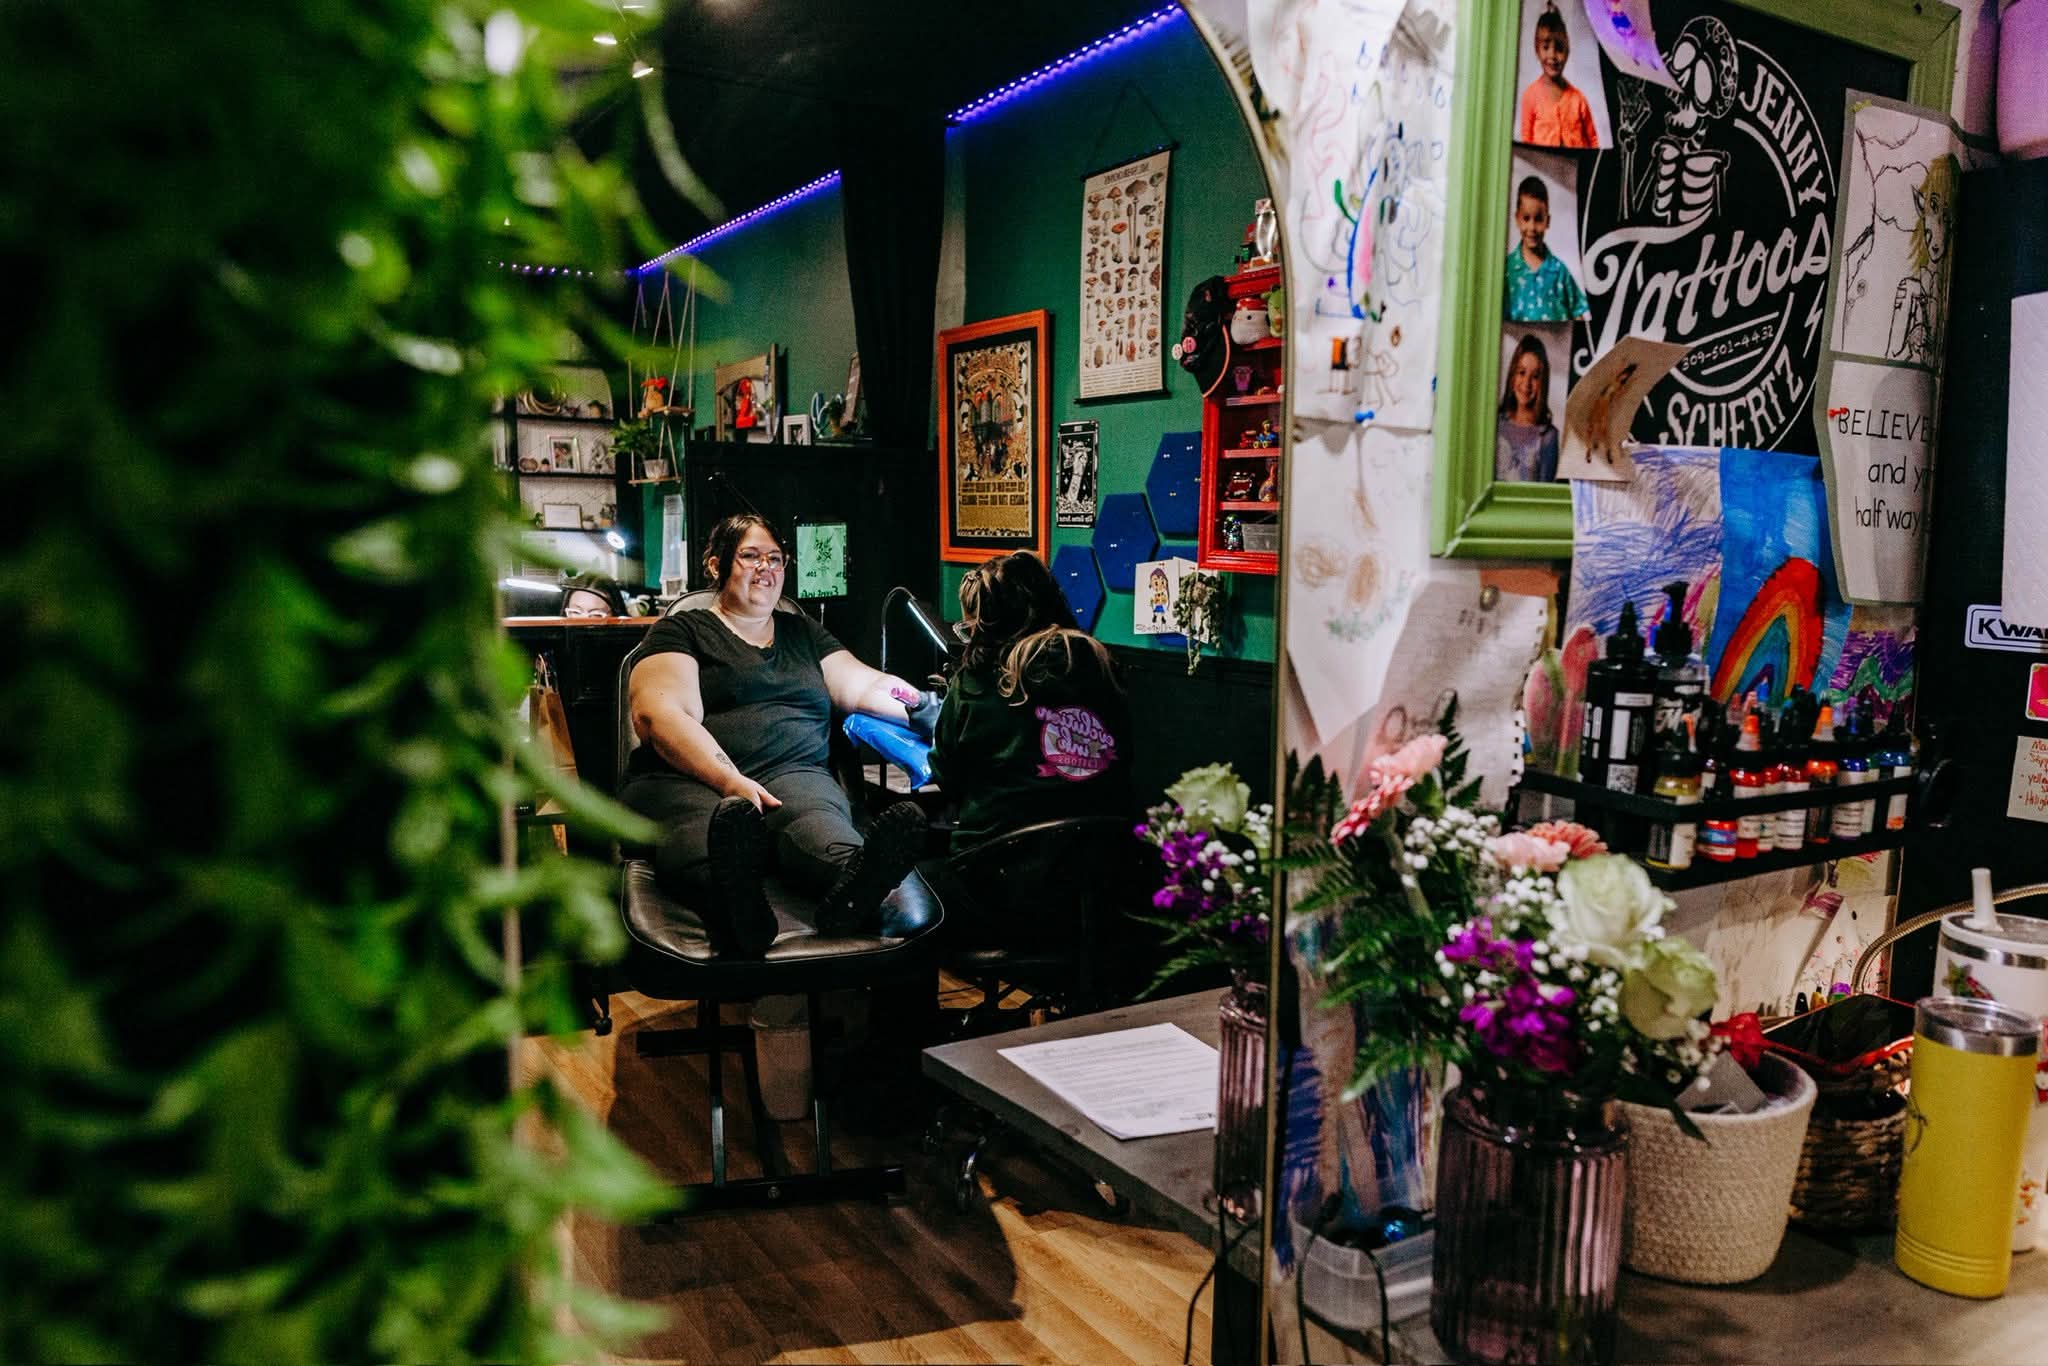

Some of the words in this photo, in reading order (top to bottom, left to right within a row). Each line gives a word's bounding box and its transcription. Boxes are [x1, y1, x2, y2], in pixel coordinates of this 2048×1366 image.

[1739, 63, 1827, 205] JENNY
[1573, 207, 1831, 374] Tattoos
[1659, 344, 1804, 449] SCHERTZ
[1838, 407, 1930, 442] BELIEVE
[1868, 456, 1907, 485] and
[1855, 495, 1886, 528] half
[1887, 508, 1921, 537] way
[1978, 617, 2048, 640] KWA
